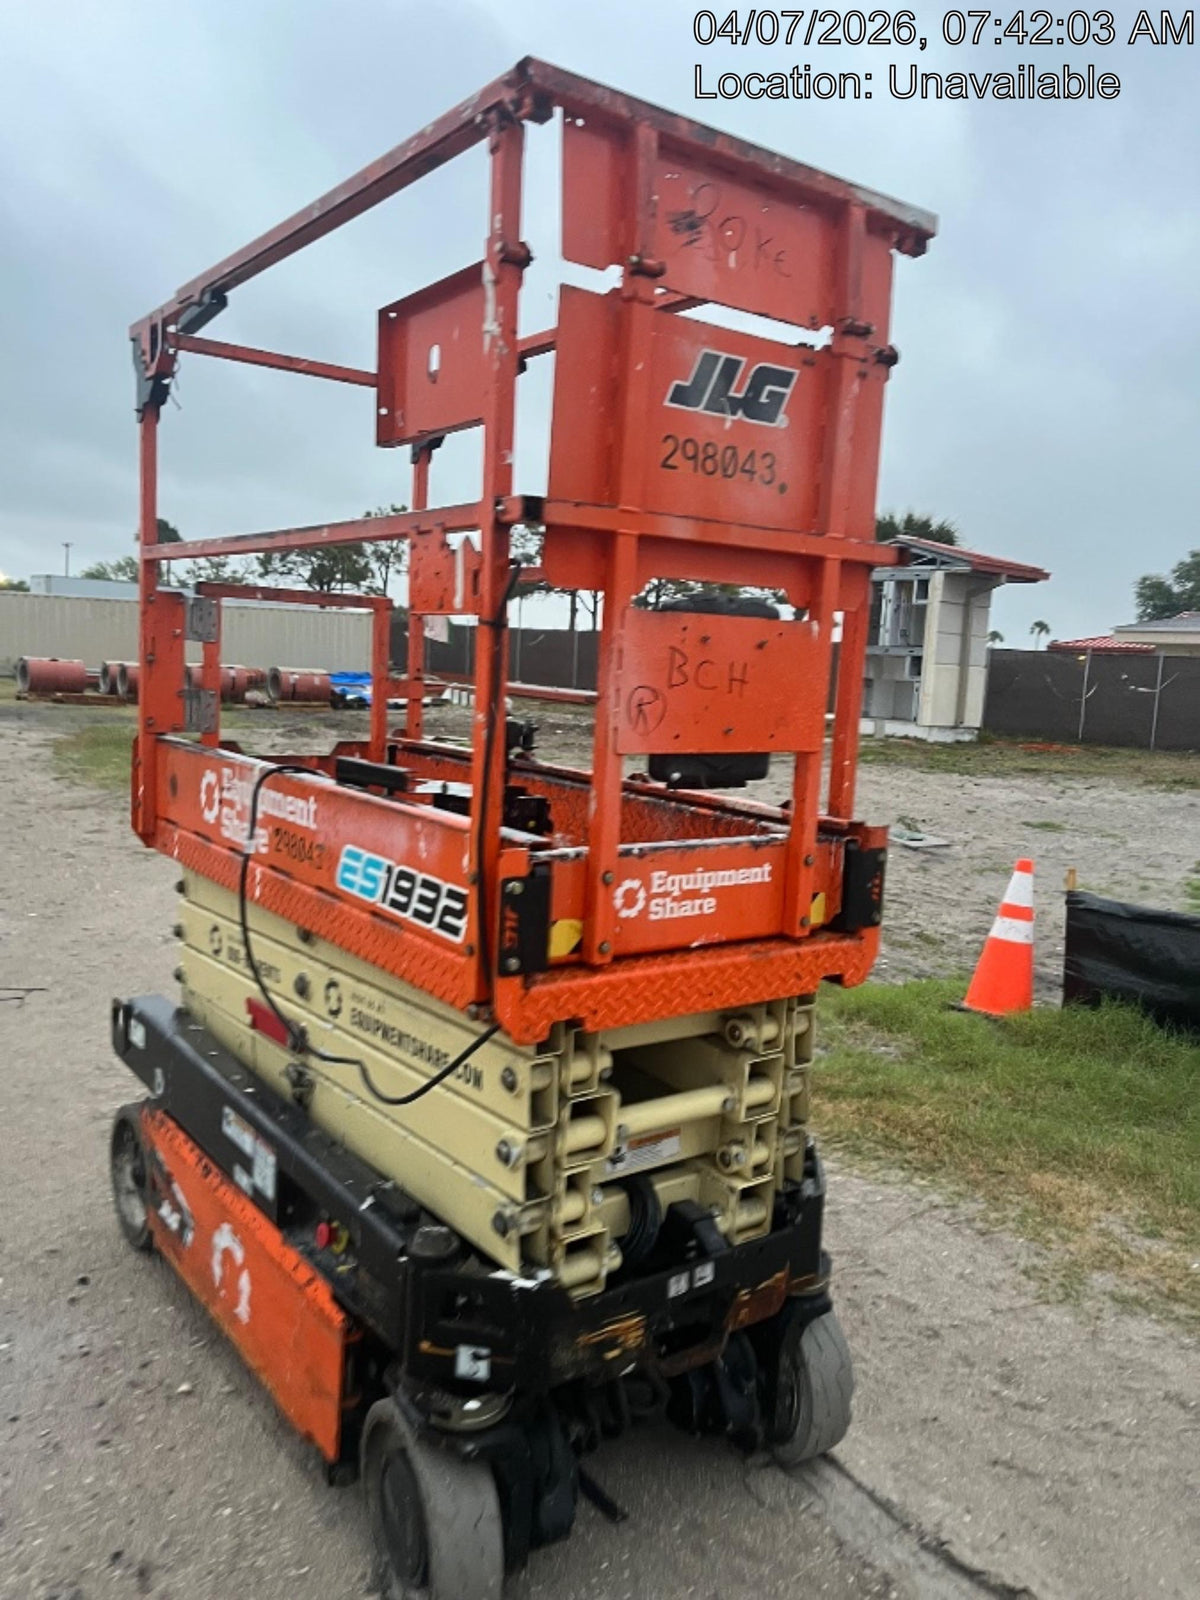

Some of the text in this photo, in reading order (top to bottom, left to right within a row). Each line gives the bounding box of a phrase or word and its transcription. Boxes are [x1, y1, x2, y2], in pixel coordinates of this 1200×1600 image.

[663, 349, 800, 428] JLG
[660, 434, 777, 486] 298043
[667, 646, 749, 699] BCH
[221, 767, 317, 830] Equpment
[338, 845, 470, 943] ES1932
[650, 862, 772, 896] Equipment
[648, 897, 717, 920] Share
